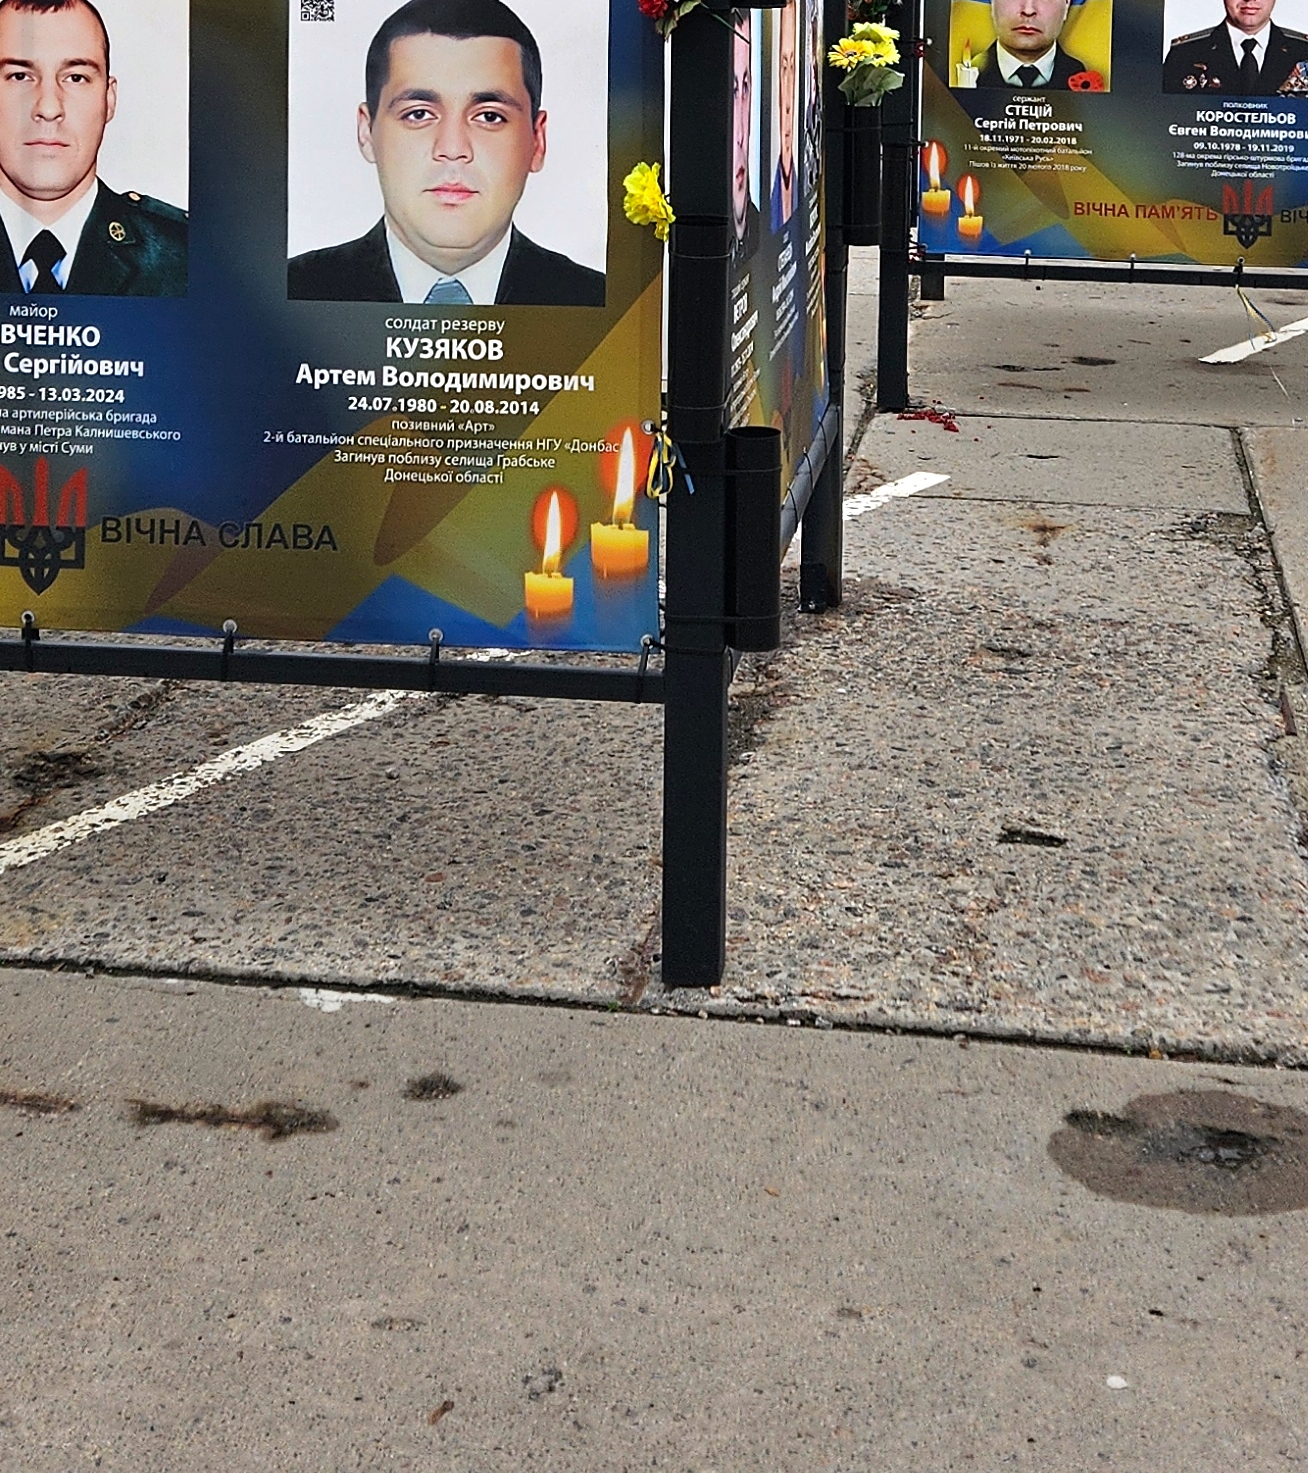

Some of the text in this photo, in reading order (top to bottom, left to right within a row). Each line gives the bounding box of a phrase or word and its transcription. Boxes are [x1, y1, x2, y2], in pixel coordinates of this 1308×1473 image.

[1005, 104, 1052, 118] СТЕЦІЙ
[1196, 110, 1296, 124] КОРОСТЕЛЬОВ
[974, 117, 1083, 133] Сергій Петрович
[1168, 124, 1207, 136] Євген
[1073, 202, 1129, 218] ВІЧНА
[9, 303, 58, 320] майор
[384, 317, 505, 334] солдат резерву
[386, 337, 504, 360] КУЗЯКОВ
[3, 352, 144, 377] Сергійович
[295, 363, 594, 393] Артем Володимирович
[38, 387, 125, 403] 13.03.2024
[347, 396, 540, 414] 24.07.1980 20.08.2014
[34, 423, 72, 439] Петра
[74, 425, 181, 440] Калнишевського
[19, 442, 27, 455] у
[28, 440, 59, 453] місті
[60, 441, 93, 456] Суми
[334, 449, 555, 469] Загинув поблизу селища Грабське
[383, 468, 503, 483] Донецької області
[101, 516, 339, 552] ВІЧНА СЛАВА
